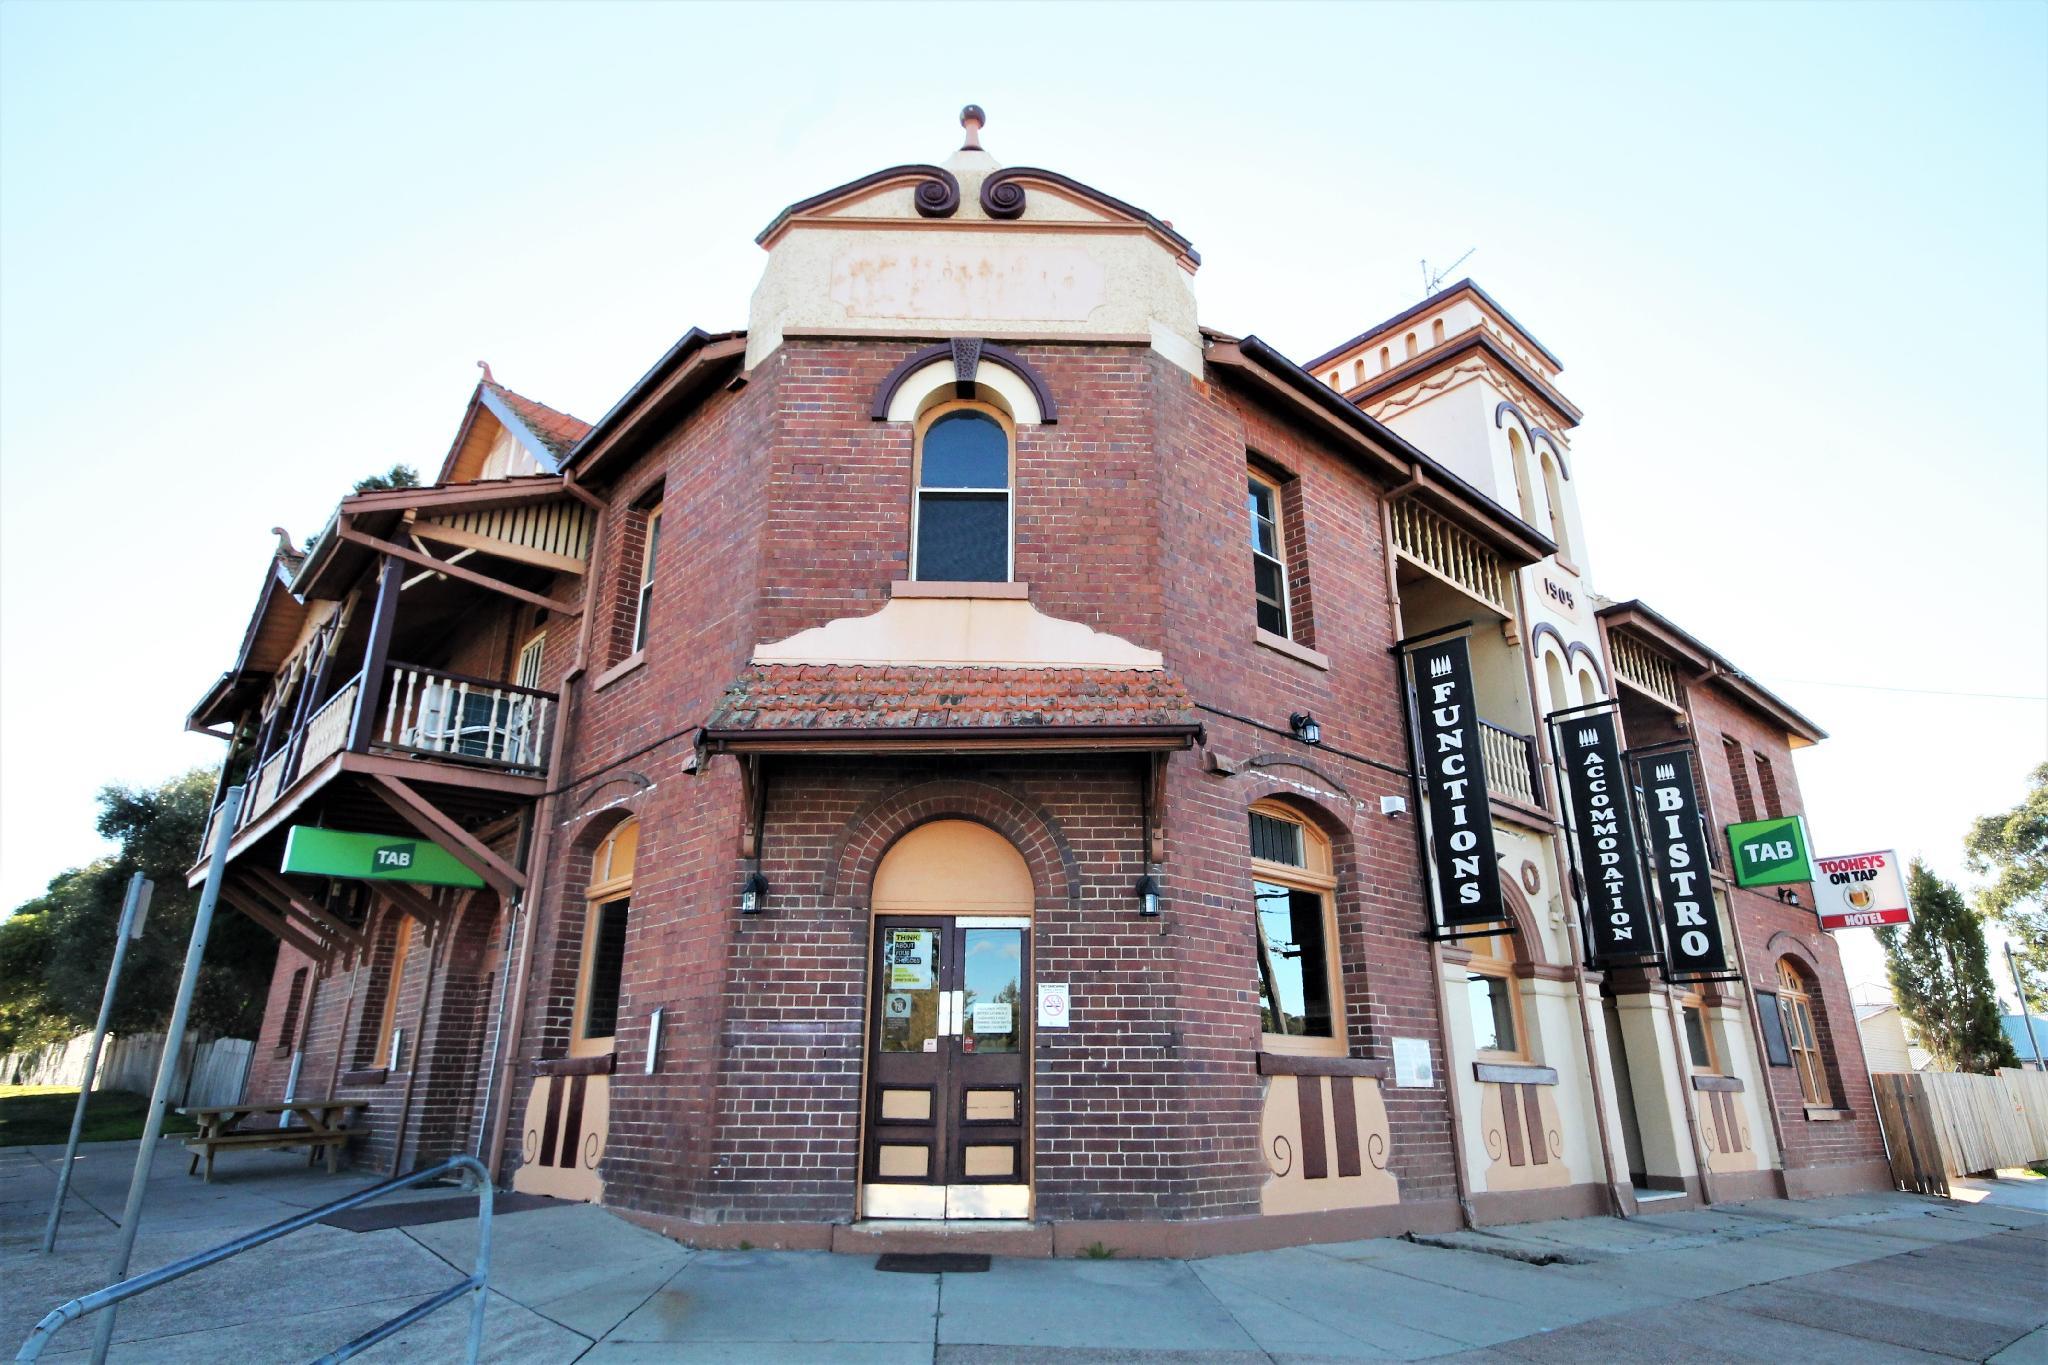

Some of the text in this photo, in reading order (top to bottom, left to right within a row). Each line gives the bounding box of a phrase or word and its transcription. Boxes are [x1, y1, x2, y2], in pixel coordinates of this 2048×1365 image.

[1544, 578, 1575, 610] 1905
[1432, 681, 1481, 904] FUNCTIONS
[377, 850, 410, 866] TAB
[1584, 752, 1633, 941] ACCOMMODATION
[1744, 840, 1794, 863] TAB
[1655, 787, 1710, 957] BISTRO
[1819, 855, 1886, 874] TOOHEYS
[1830, 869, 1878, 885] ON TAP
[1844, 913, 1885, 926] HOTEL
